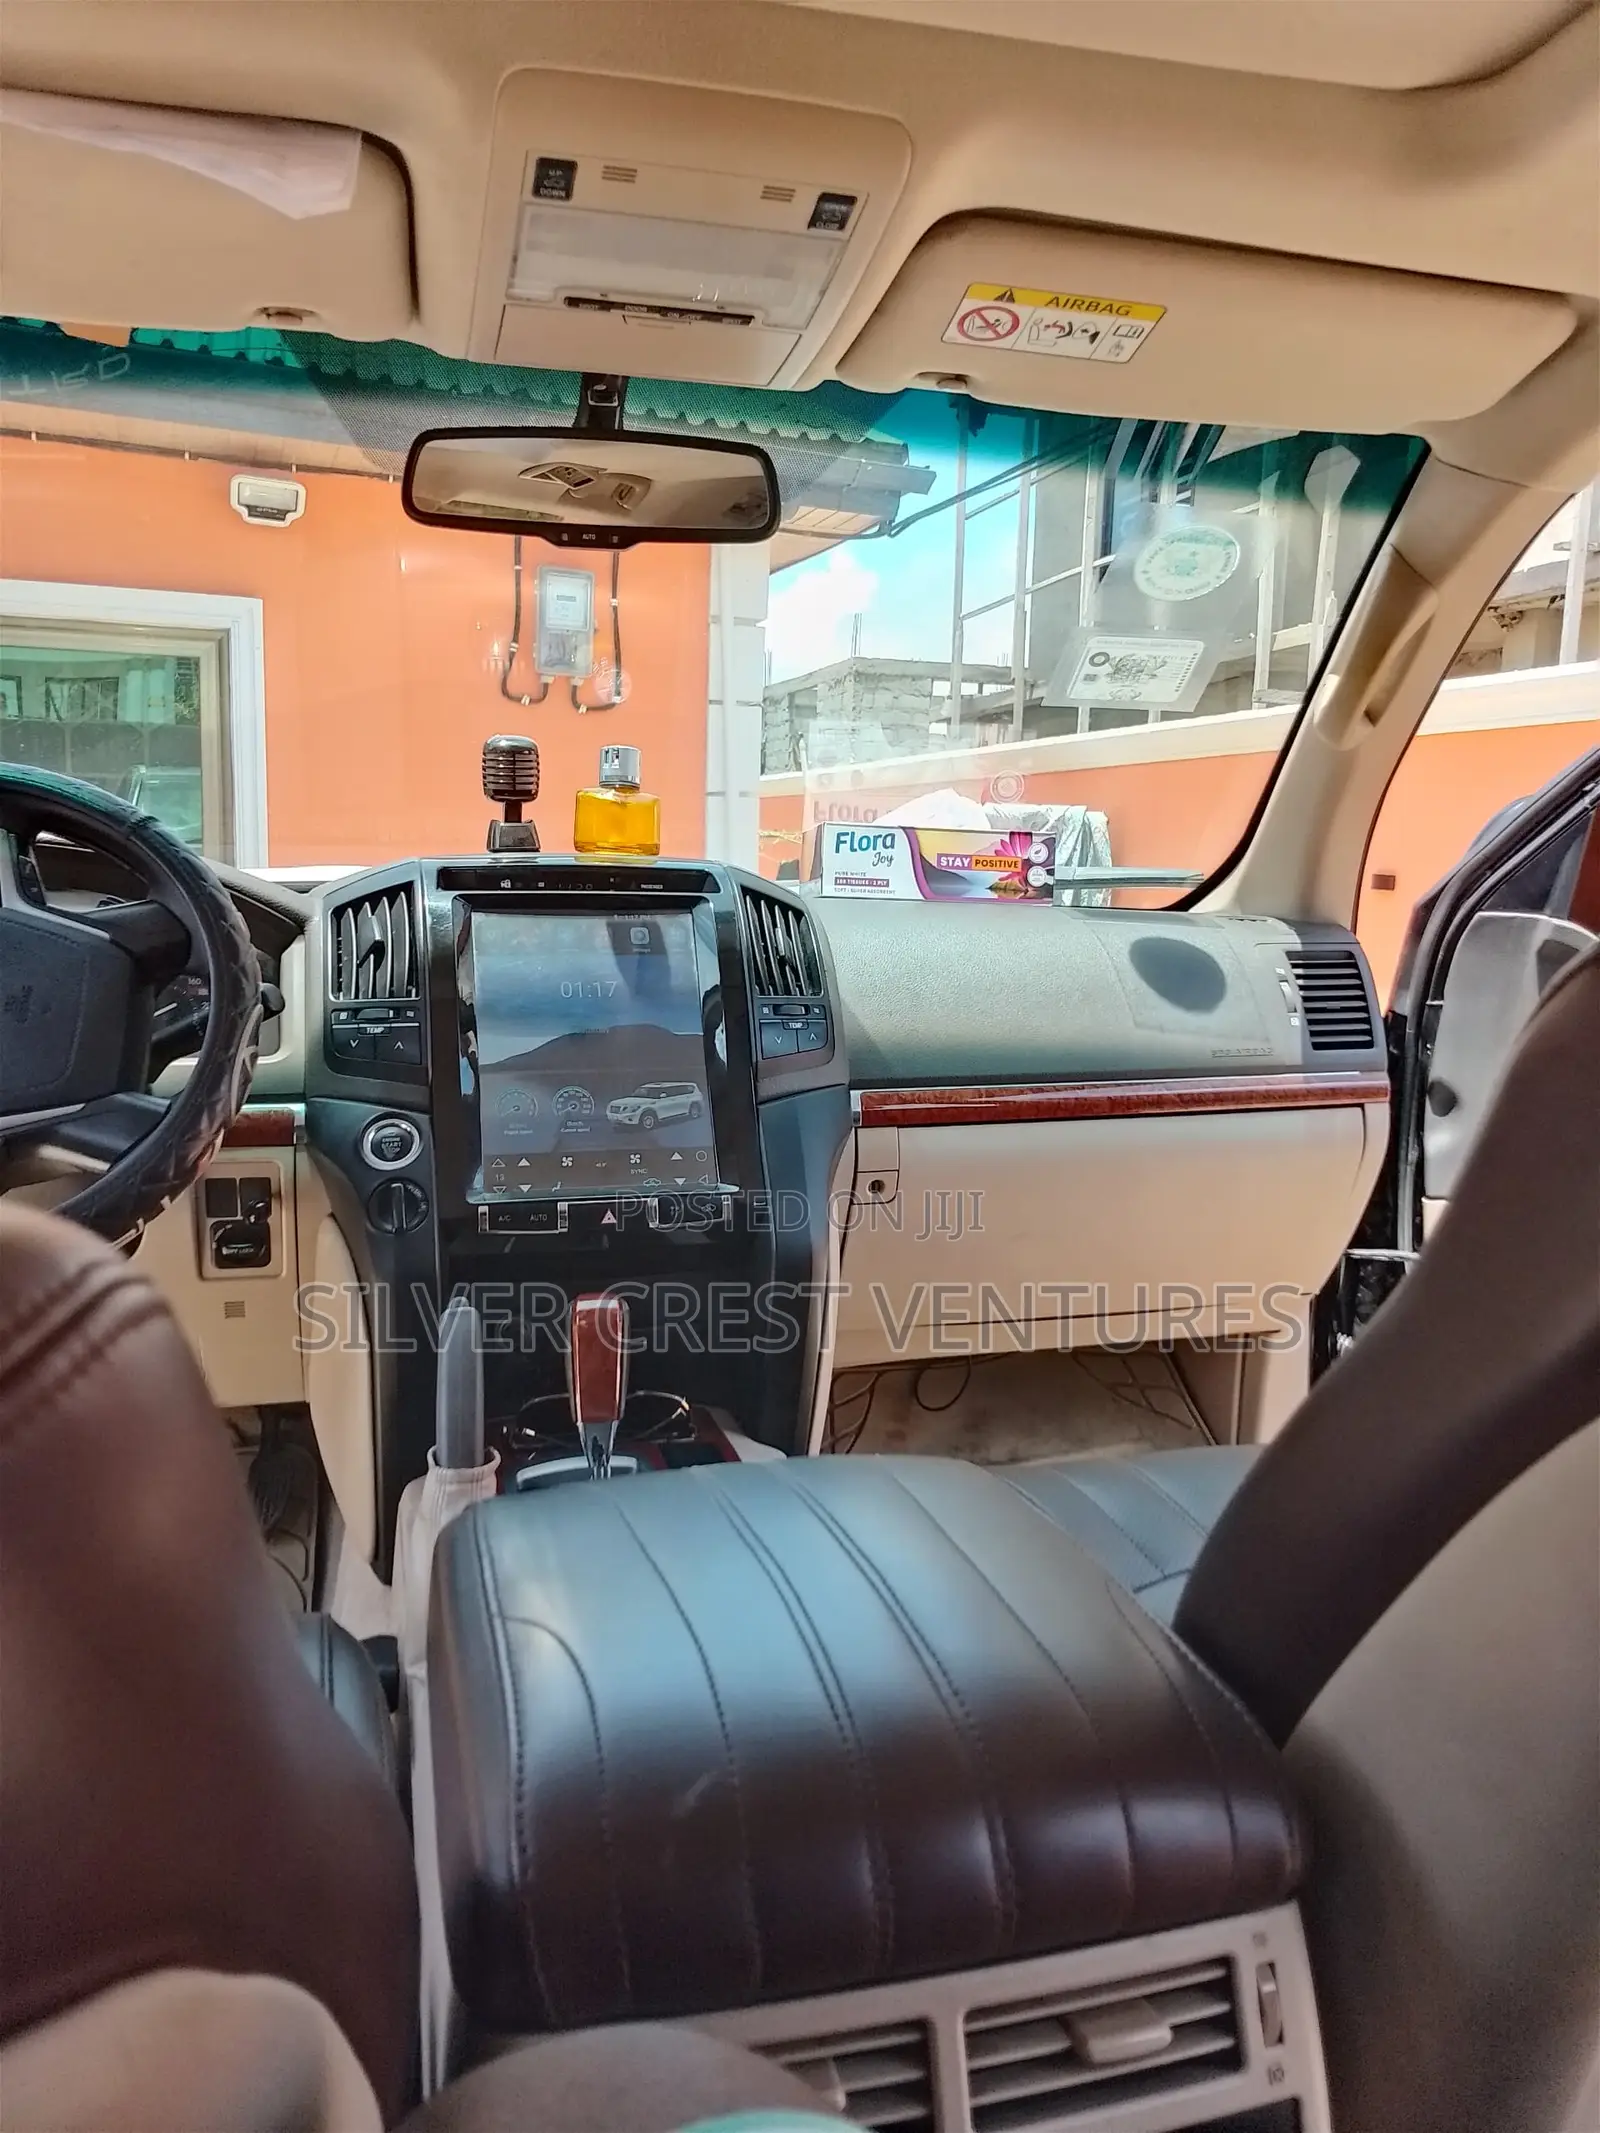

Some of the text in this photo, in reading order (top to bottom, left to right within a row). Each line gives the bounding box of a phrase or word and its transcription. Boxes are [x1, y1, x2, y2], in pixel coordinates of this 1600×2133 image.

[1044, 296, 1133, 316] AIRBAG
[835, 831, 896, 854] Flora
[872, 851, 894, 867] Joy
[940, 856, 970, 867] STAY
[974, 858, 1019, 869] POSITIVE
[560, 981, 618, 999] 01:17
[498, 1213, 512, 1221] A/C
[530, 1213, 548, 1221] AUTO
